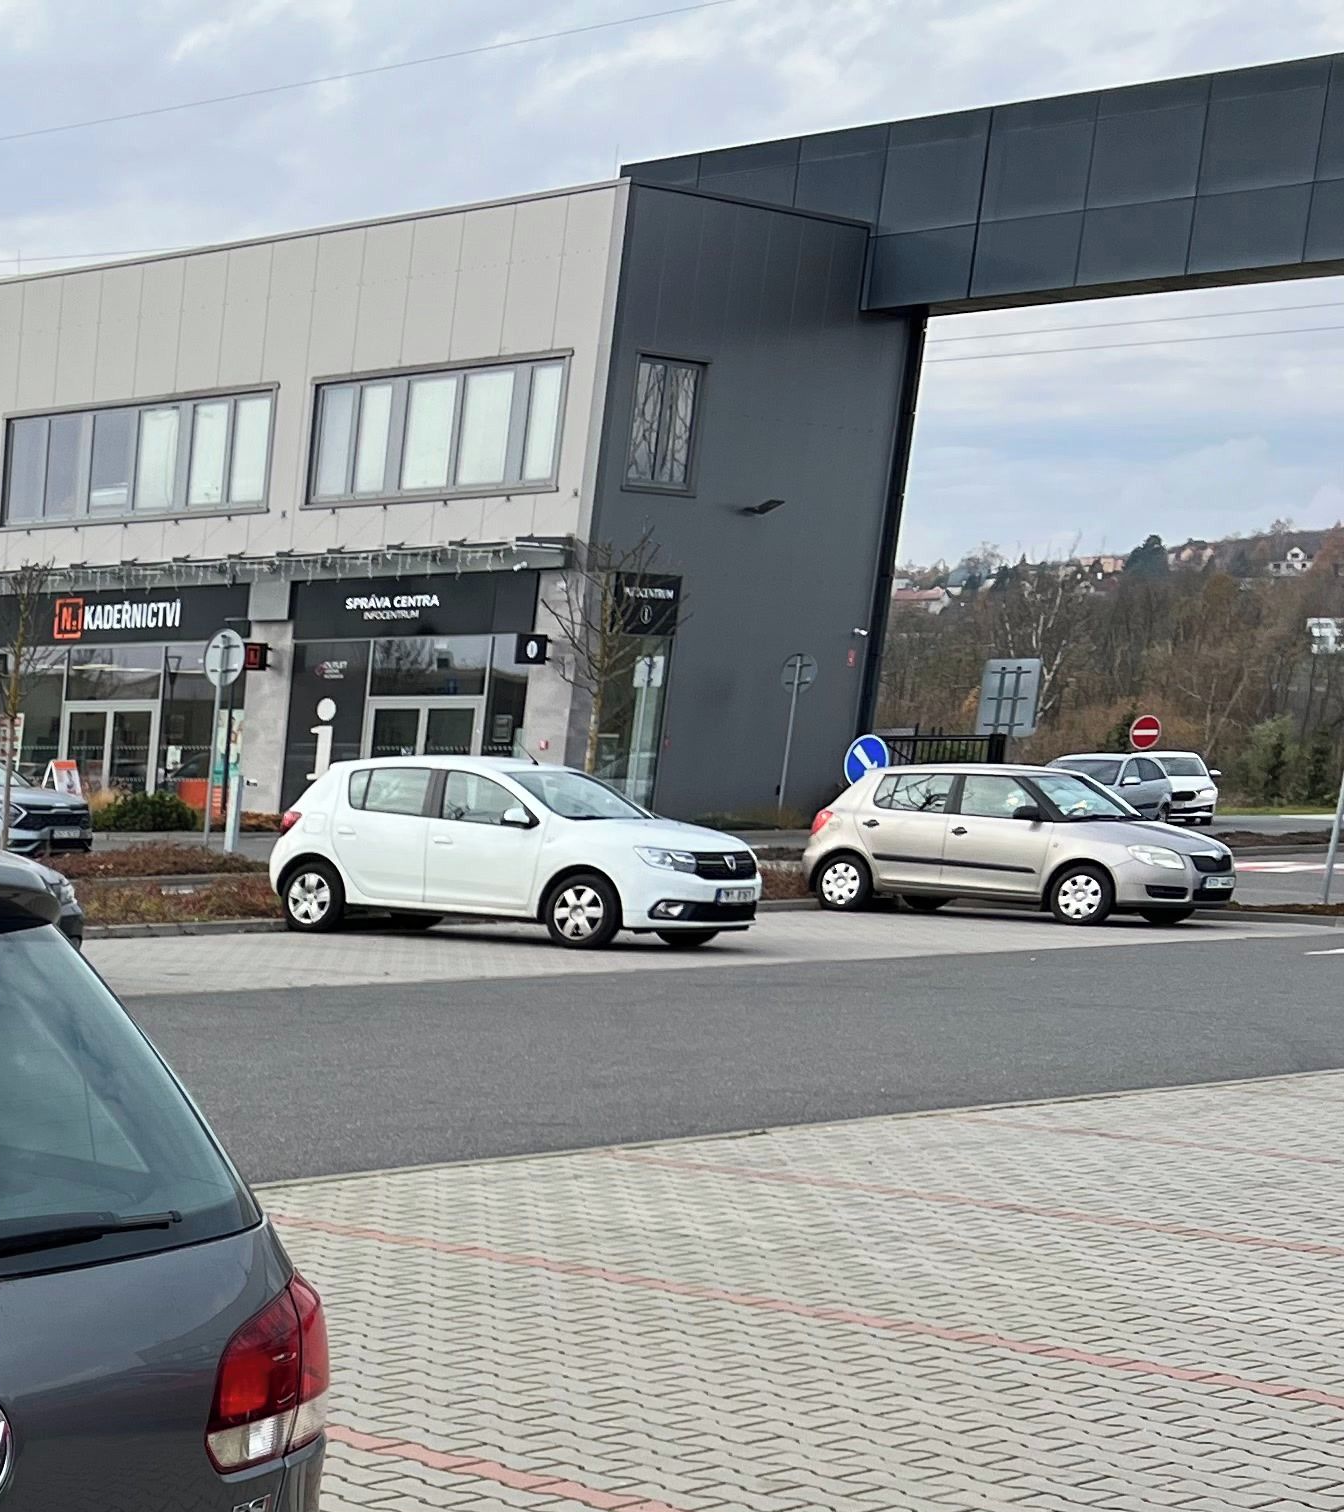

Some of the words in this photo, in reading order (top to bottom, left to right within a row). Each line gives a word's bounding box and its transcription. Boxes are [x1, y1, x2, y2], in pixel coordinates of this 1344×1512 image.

[345, 593, 392, 610] SPRÁVA
[393, 594, 440, 608] CENTRA
[83, 599, 181, 630] KADEŘNICTVÍ
